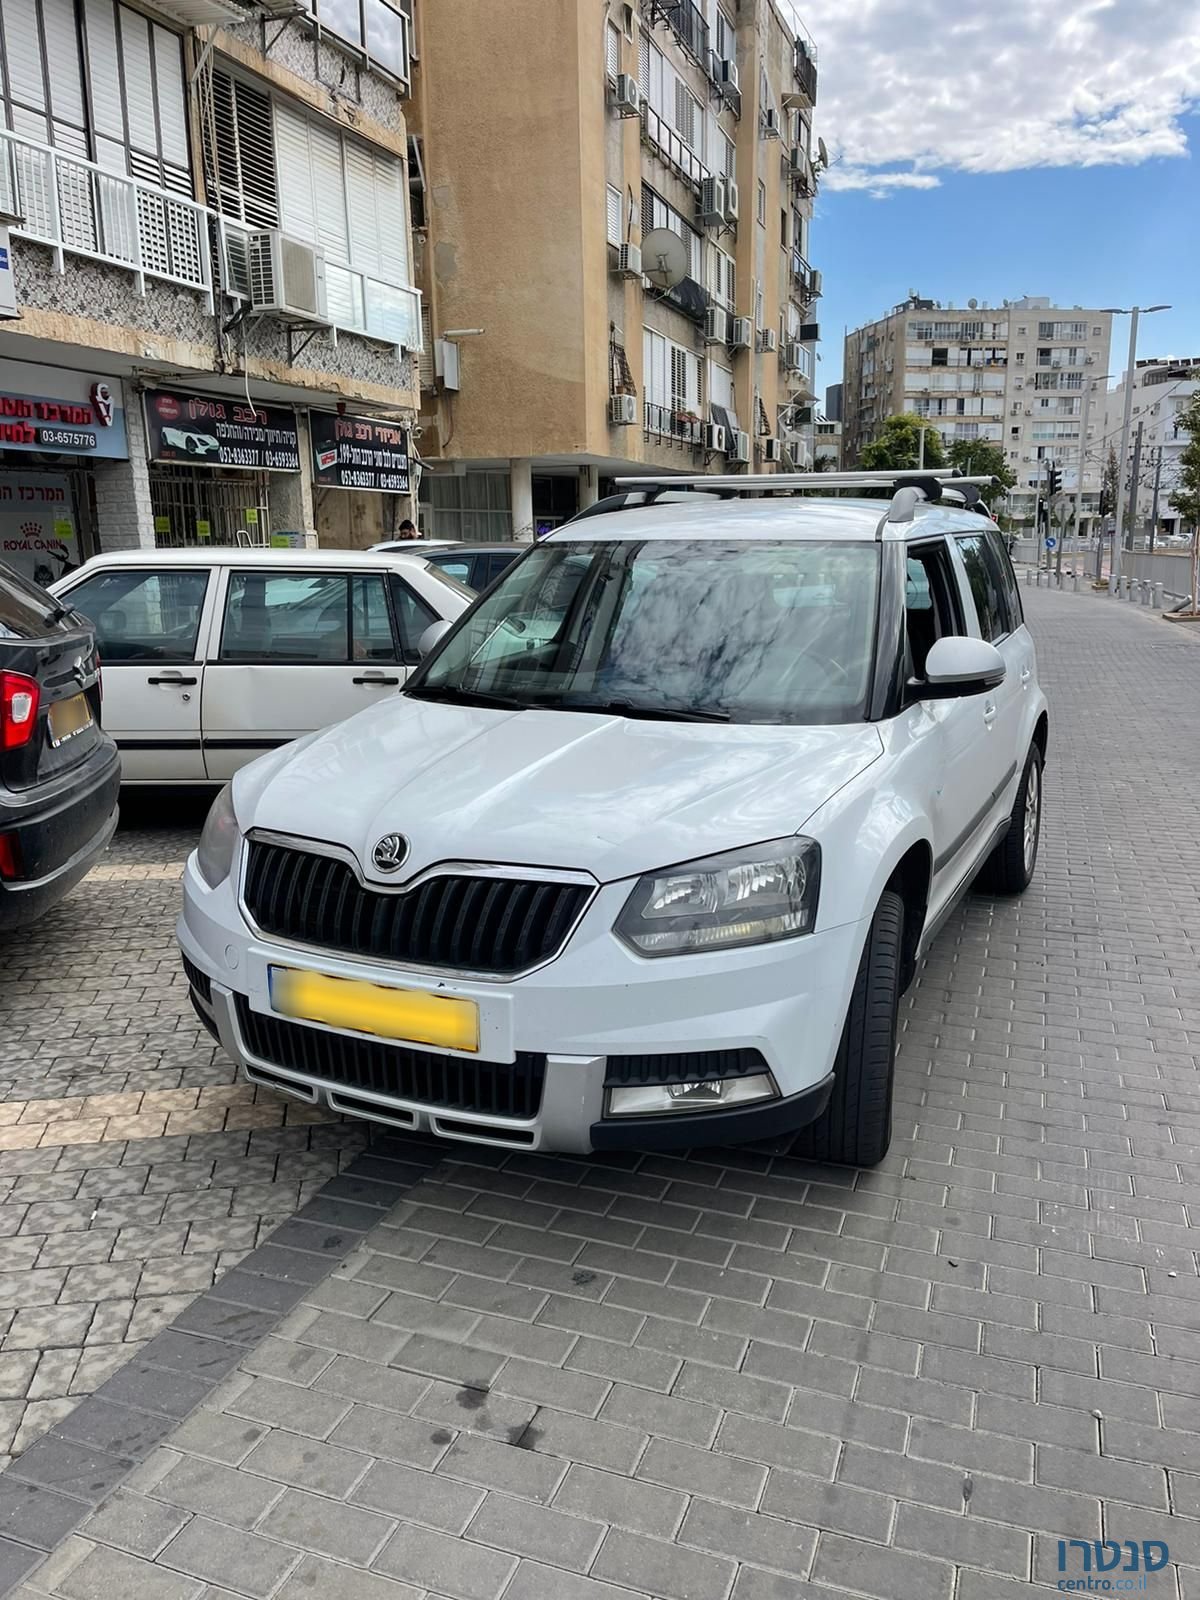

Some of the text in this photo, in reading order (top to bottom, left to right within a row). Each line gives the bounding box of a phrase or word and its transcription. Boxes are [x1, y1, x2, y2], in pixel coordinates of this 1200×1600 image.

[38, 402, 95, 426] המרכז
[188, 397, 268, 425] רכב גולן
[42, 430, 96, 447] 03-6575776
[335, 417, 402, 446] אביזרי רכב גולן
[265, 450, 300, 469] 03-6593364
[18, 485, 65, 501] המרכז
[3, 539, 62, 551] ROYAL CANIN
